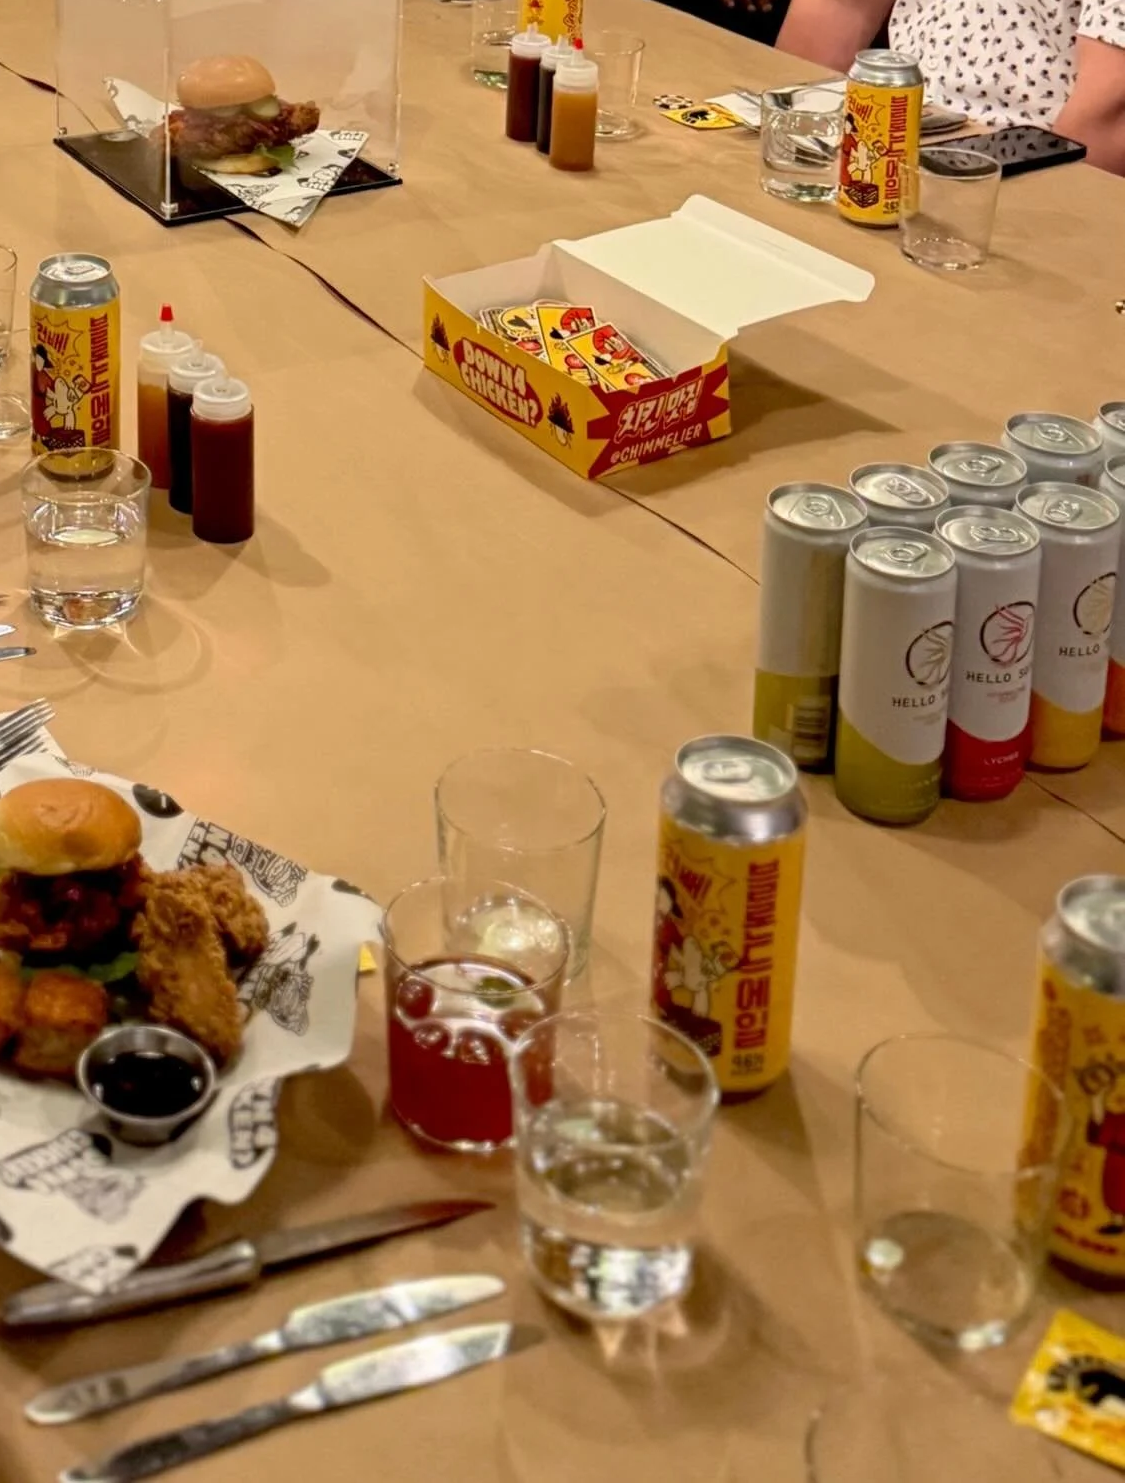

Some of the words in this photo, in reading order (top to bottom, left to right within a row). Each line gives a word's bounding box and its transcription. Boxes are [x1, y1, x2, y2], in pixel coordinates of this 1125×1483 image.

[462, 338, 514, 391] DOWN
[513, 365, 527, 396] 4
[460, 361, 539, 427] CHICKEN?
[618, 395, 665, 437] 치킨
[666, 379, 703, 424] 맛집
[610, 423, 703, 464] @CHIMMELIER
[1059, 643, 1101, 657] HELLO
[965, 670, 1011, 684] HELLO
[892, 694, 935, 708] HELLO
[984, 751, 1019, 766] LYCHEE
